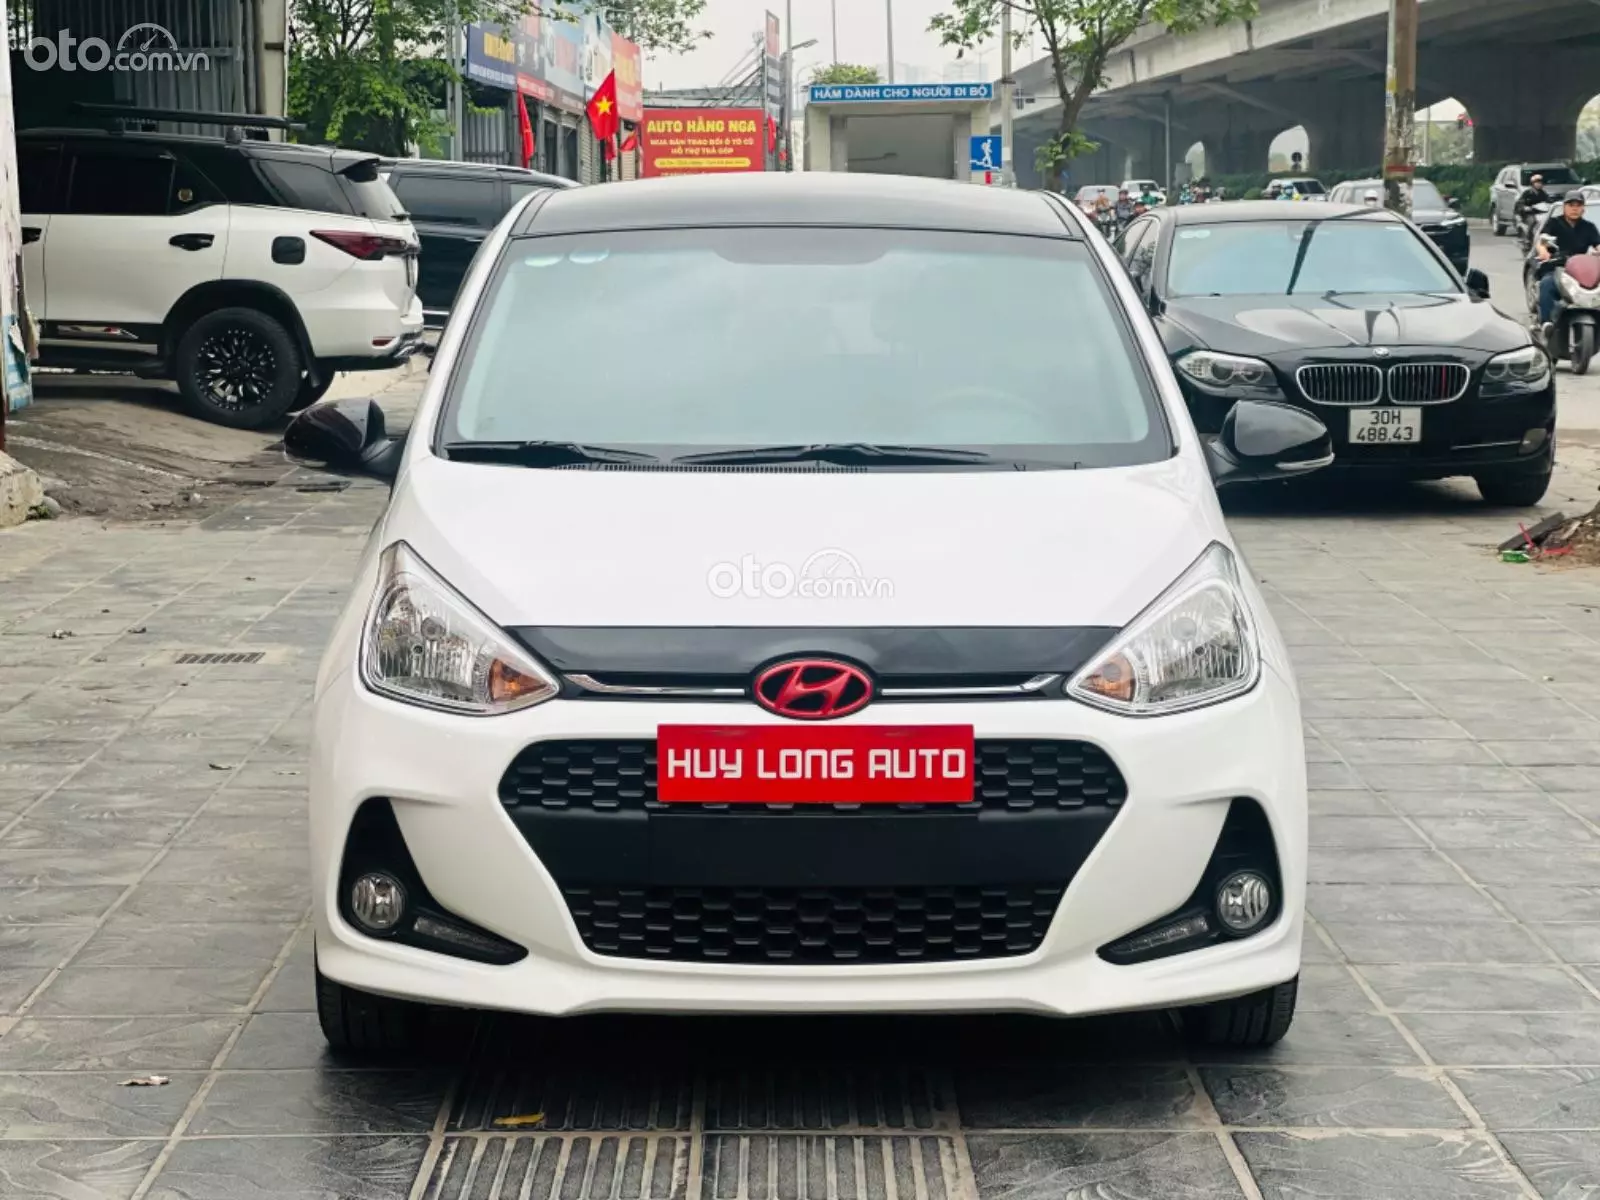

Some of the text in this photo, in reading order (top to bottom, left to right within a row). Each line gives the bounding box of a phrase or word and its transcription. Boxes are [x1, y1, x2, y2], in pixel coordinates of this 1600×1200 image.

[814, 84, 988, 99] HẦM DÀNH CHO NGƯỜI ĐI BỘ
[647, 120, 683, 133] AUTO
[728, 120, 757, 133] NGA
[1370, 410, 1401, 425] 30H
[1356, 426, 1413, 441] 488.43
[667, 748, 966, 779] HUY LONG AUTO
